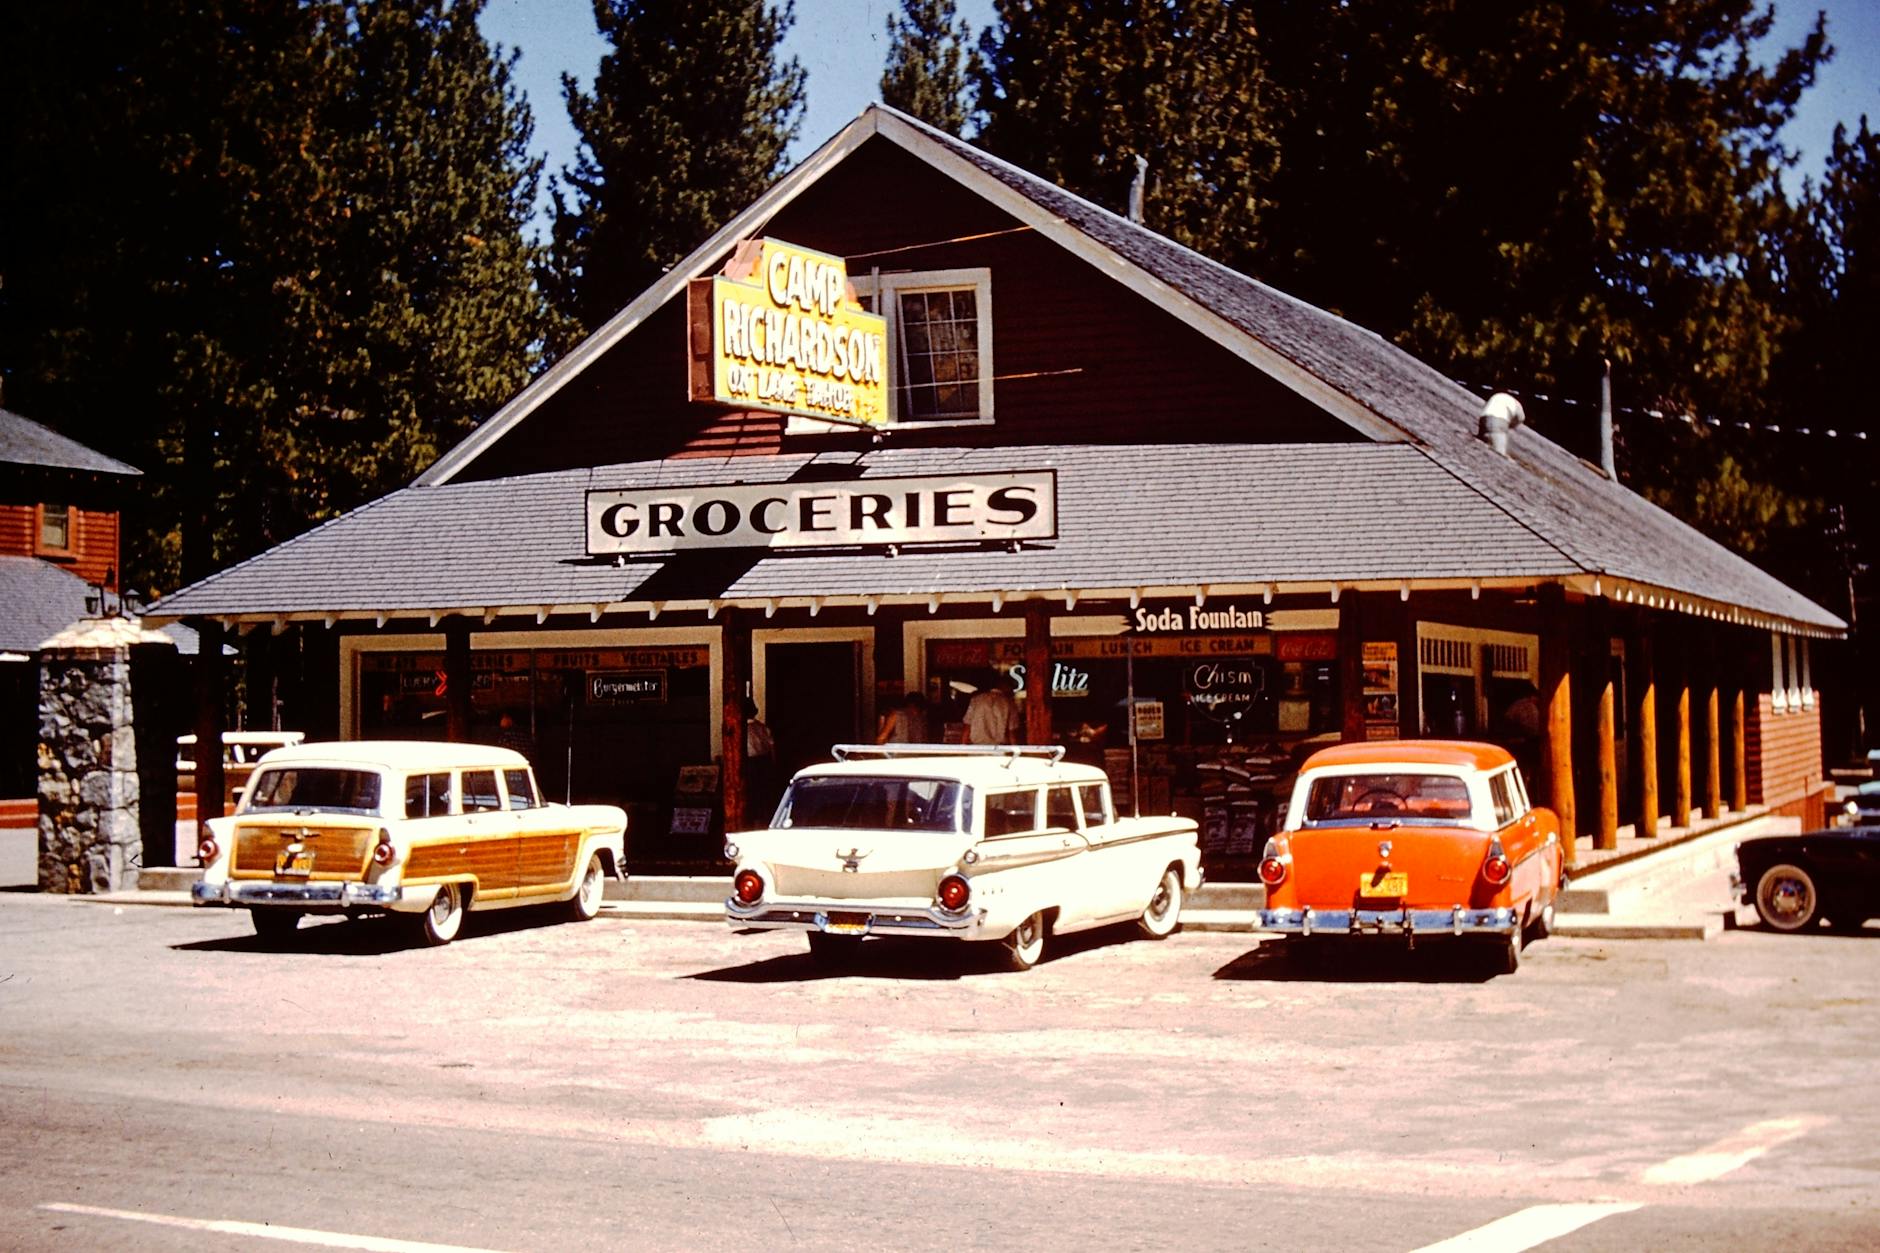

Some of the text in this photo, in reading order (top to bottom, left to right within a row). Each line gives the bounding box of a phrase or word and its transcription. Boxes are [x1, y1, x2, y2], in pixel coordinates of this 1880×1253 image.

[769, 251, 843, 316] CAMP
[723, 299, 880, 383] RICHARDSON
[600, 486, 1038, 537] GROCERIES
[1135, 605, 1263, 632] Soda Fountain
[554, 654, 599, 667] FRUITS
[622, 651, 698, 664] VEGETABLES
[1003, 639, 1254, 655] FOAIN LUNCH ICE CREAM
[1009, 662, 1089, 692] Slitz
[1194, 663, 1252, 689] Chism
